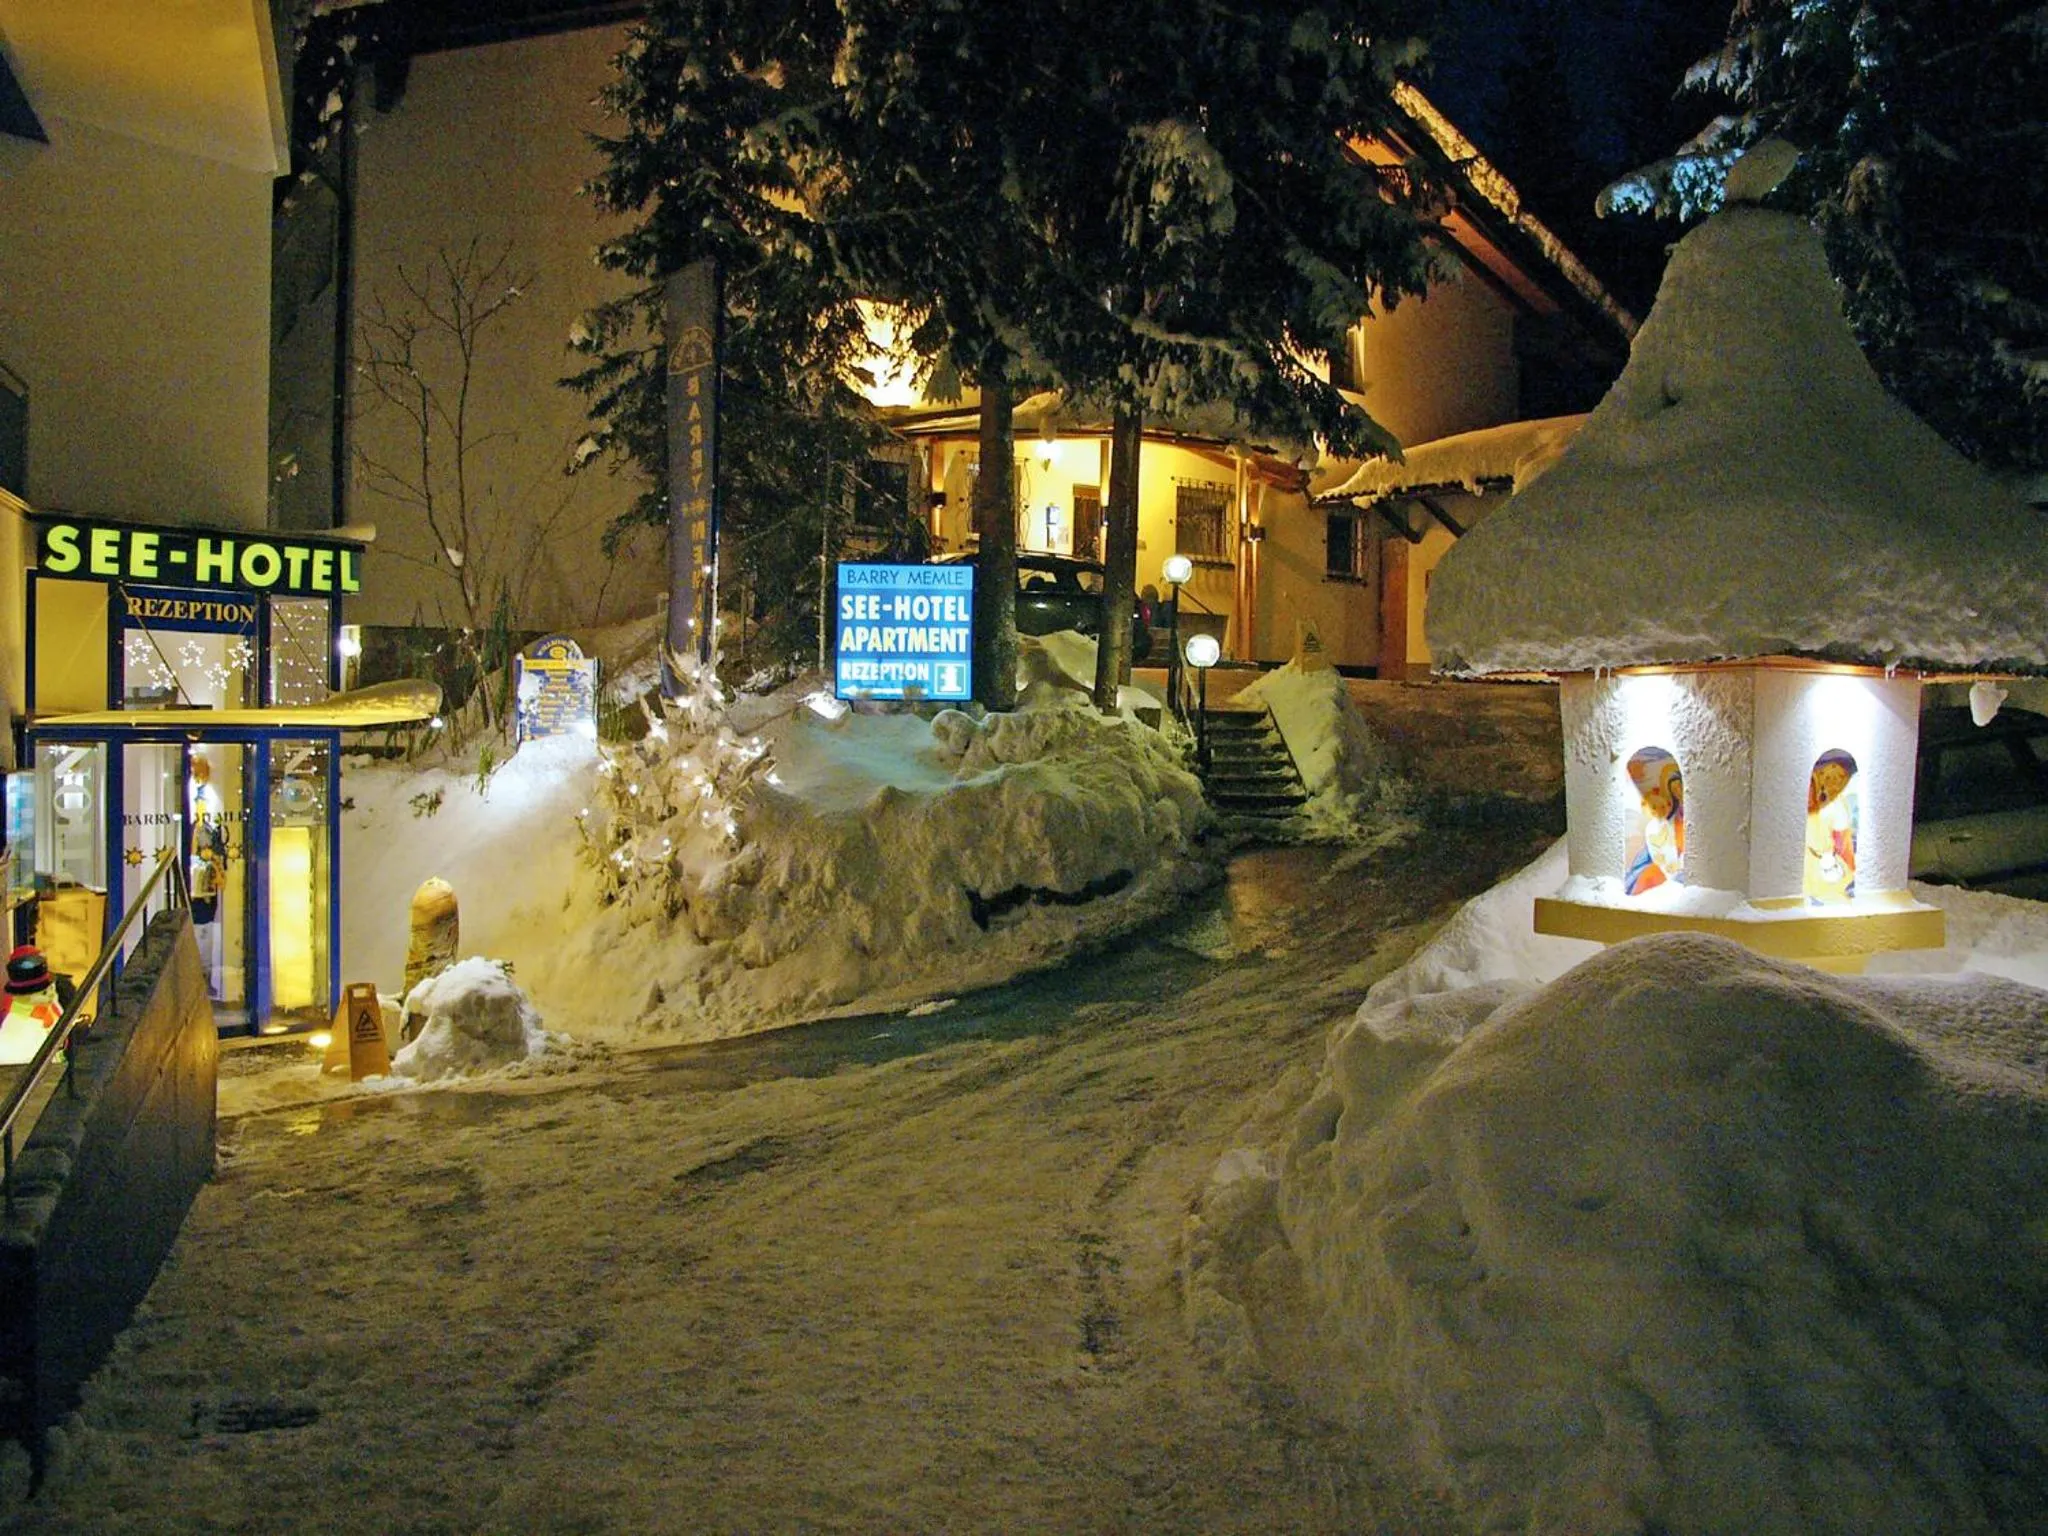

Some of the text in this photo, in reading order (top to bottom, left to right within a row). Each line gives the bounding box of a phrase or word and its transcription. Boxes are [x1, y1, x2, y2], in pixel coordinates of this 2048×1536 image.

[45, 525, 360, 592] SEE-HOTEL
[847, 569, 964, 585] BARRY MEMLE
[126, 597, 257, 623] REZEPTION
[841, 595, 970, 621] SEE-HOTEL
[840, 626, 969, 653] APARTMENT
[840, 661, 929, 681] REZEPTION
